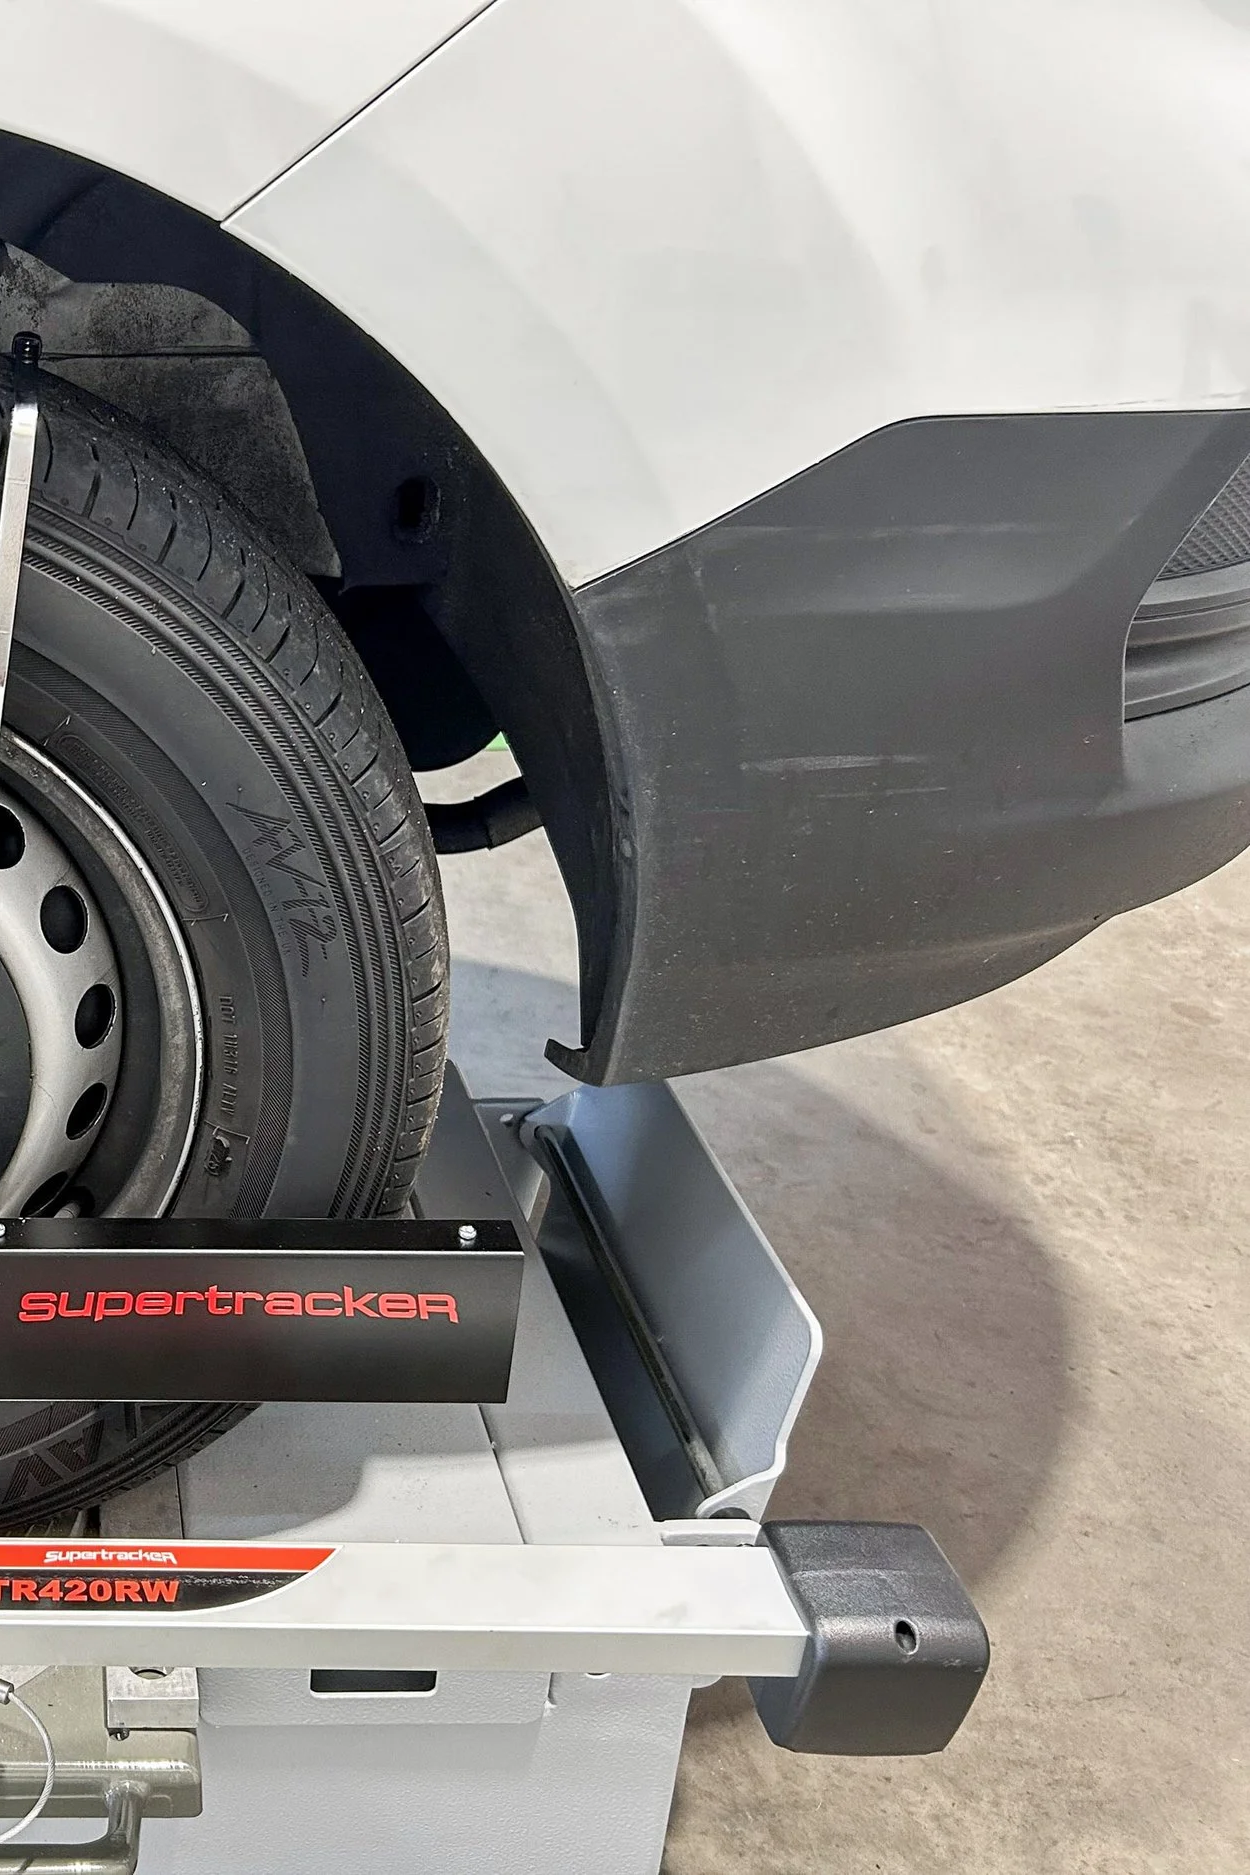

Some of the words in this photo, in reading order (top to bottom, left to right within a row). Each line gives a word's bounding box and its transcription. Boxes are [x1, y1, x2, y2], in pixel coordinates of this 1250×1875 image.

[242, 847, 273, 898] DESIGNED
[225, 802, 338, 978] AV12
[266, 898, 279, 913] IN
[274, 917, 289, 938] THE
[280, 942, 292, 958] UK
